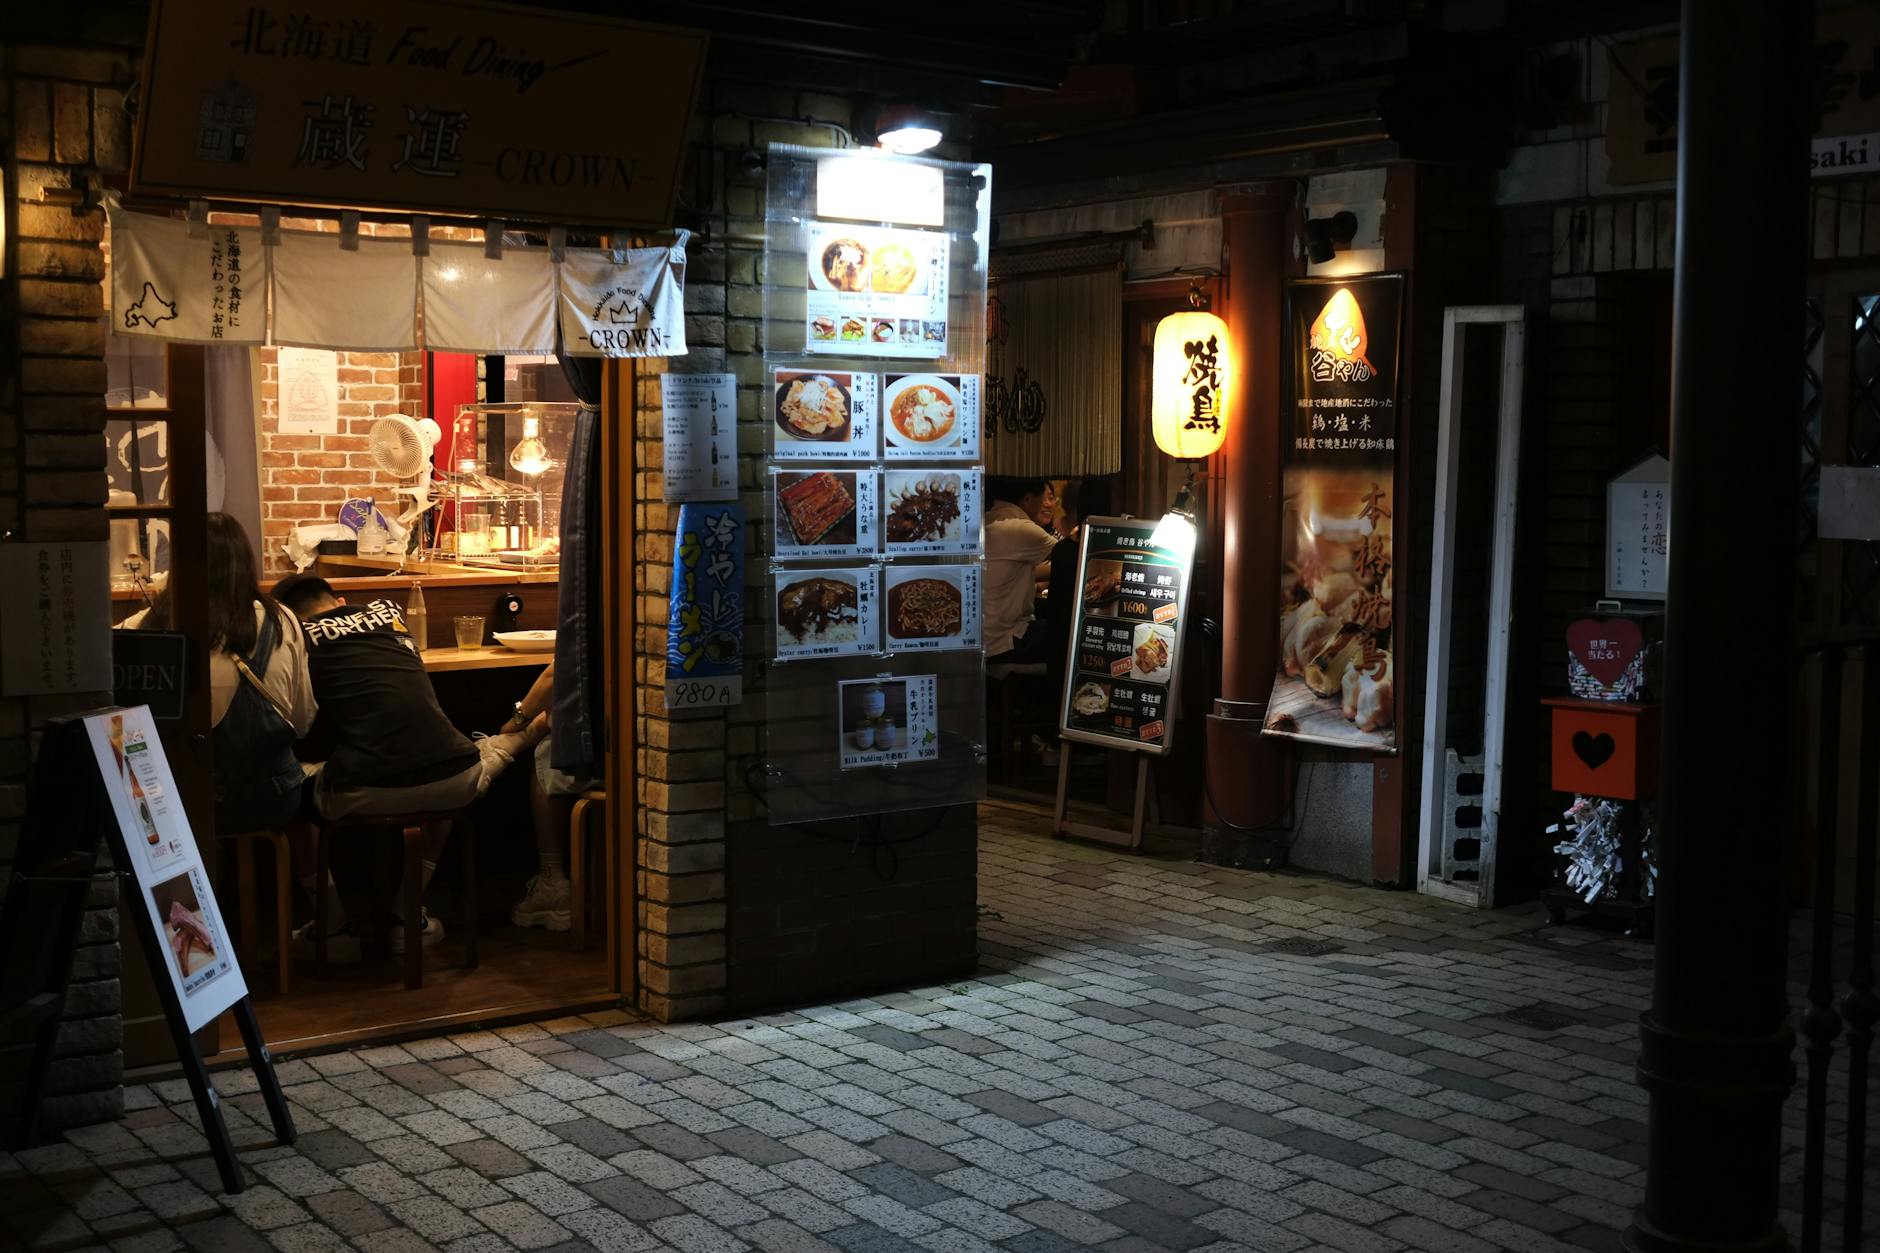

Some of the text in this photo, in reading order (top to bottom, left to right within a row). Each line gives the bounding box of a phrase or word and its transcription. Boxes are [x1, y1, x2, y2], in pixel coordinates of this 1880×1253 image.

[230, 7, 552, 93] 北海道 Food Dining
[211, 241, 225, 340] こだわったお店
[226, 231, 242, 328] 北海道の食材に
[592, 291, 616, 321] Hokkaido
[617, 287, 636, 297] Food
[1183, 334, 1225, 435] 焼鳥
[1311, 351, 1370, 382] 谷やん
[852, 400, 865, 440] 豚丼
[860, 482, 869, 534] 特大うな重
[704, 511, 740, 621] 冷やし
[1353, 483, 1391, 682] 本格焼鳥
[308, 608, 405, 648] FURTHER
[679, 532, 706, 673] ラーメン
[963, 575, 971, 635] カレーラーメン
[1588, 650, 1621, 660] 当たる！
[1590, 639, 1618, 650] 世界一
[114, 664, 176, 691] OPEN
[910, 690, 918, 745] 牛乳プリン
